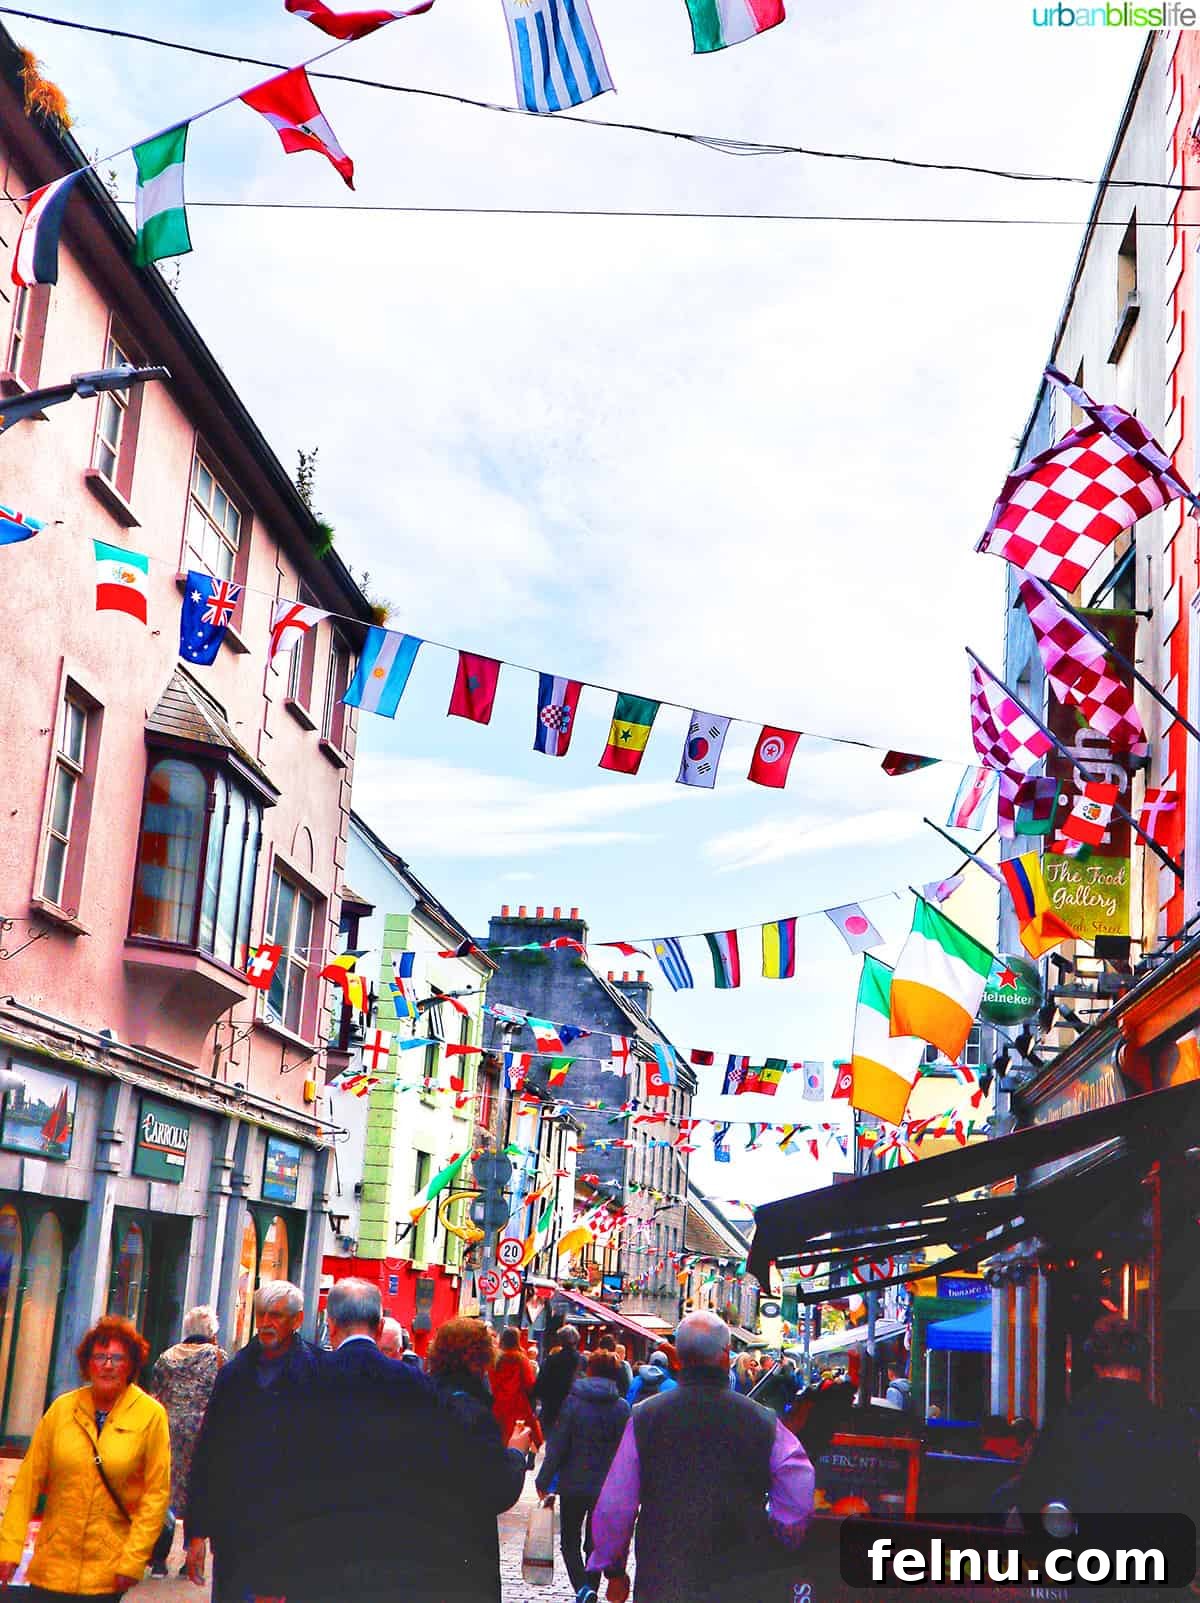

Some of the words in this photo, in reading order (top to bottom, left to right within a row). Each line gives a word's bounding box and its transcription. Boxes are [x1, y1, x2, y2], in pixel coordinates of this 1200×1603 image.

[1048, 860, 1082, 883] The
[1087, 866, 1128, 886] Food
[1053, 885, 1117, 917] Gallery
[142, 1113, 189, 1150] CARROLLS
[504, 1244, 518, 1258] 20
